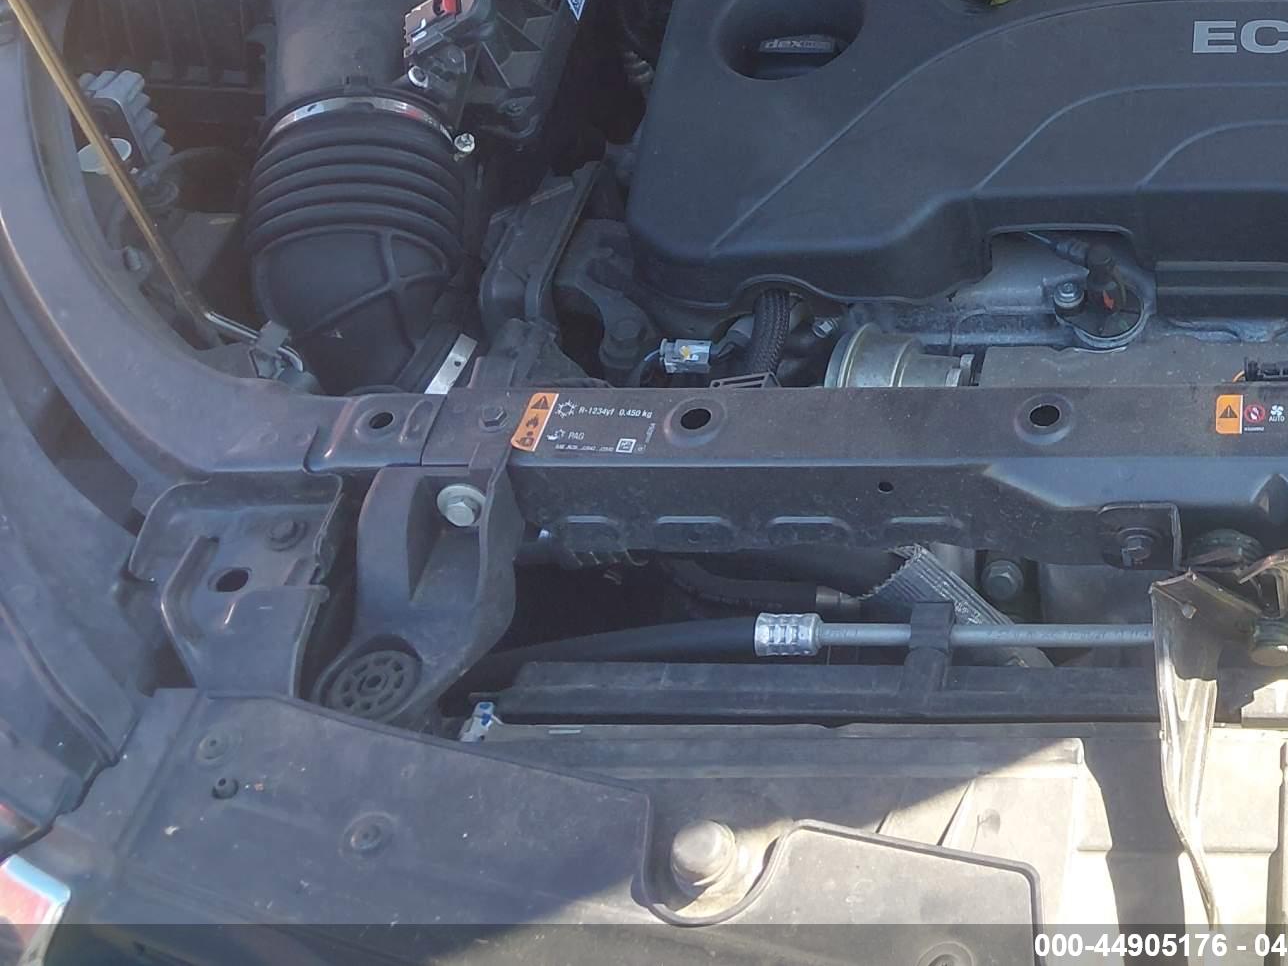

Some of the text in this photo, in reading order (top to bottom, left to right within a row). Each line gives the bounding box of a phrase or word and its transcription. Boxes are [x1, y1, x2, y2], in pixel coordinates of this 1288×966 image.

[578, 406, 653, 419] R-1234yf 0.450 kg
